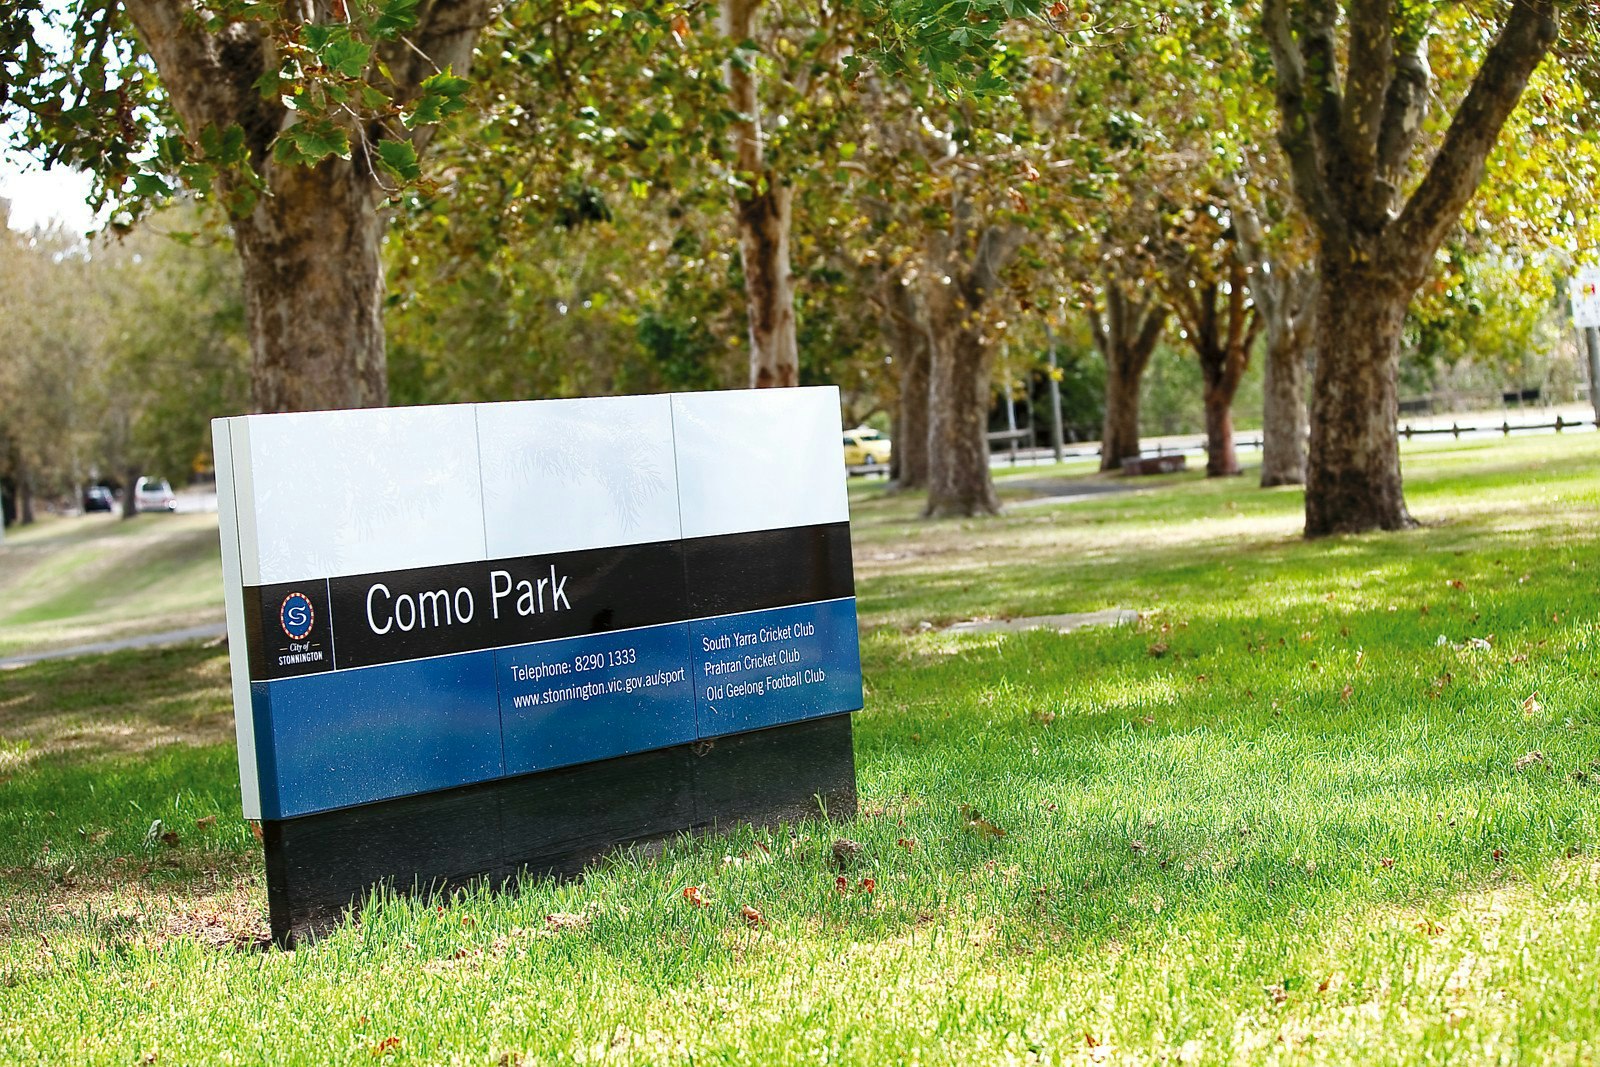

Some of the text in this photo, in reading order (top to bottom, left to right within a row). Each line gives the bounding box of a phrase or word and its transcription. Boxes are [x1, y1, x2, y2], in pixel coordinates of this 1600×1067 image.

[366, 565, 572, 635] Como Park
[289, 640, 311, 652] City of
[703, 622, 814, 651] South Yarra Cricket Club
[278, 651, 323, 666] STONNINGTON
[511, 649, 636, 682] Telephone: 8290 1333
[704, 648, 800, 675] Prahran Cricket Club
[513, 667, 685, 708] www.stonnington.vic.gov.au/sport
[706, 668, 825, 701] Old Geelong Football Club
